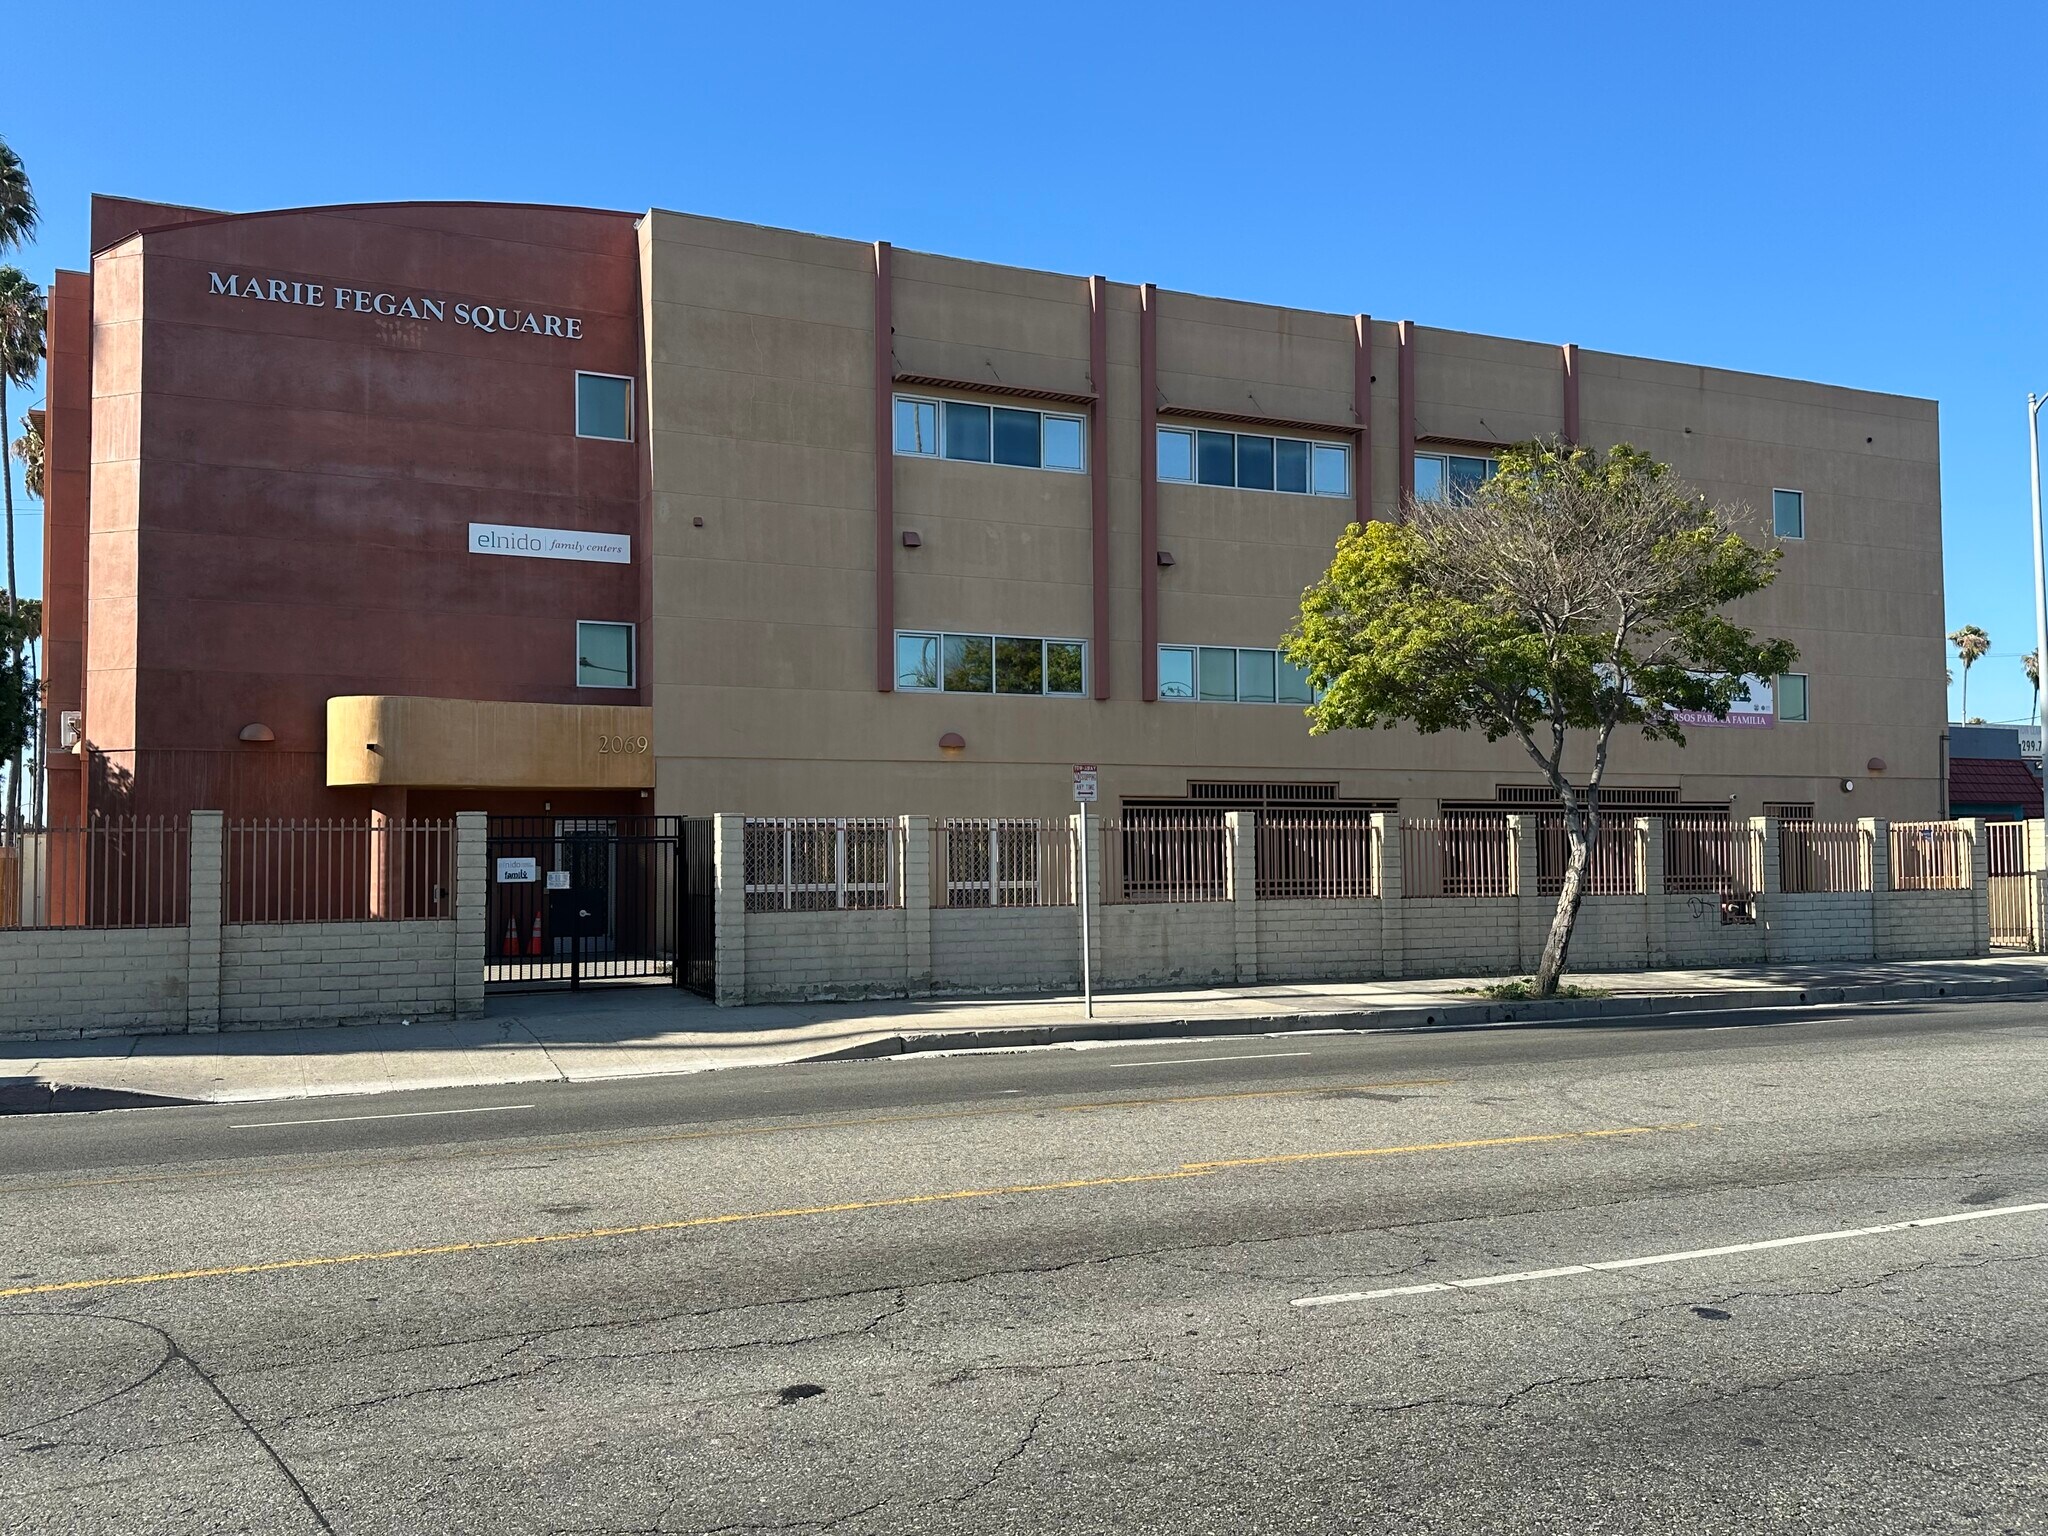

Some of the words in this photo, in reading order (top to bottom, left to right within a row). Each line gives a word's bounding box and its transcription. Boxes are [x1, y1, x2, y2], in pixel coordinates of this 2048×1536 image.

[208, 271, 325, 308] MARIE
[333, 287, 445, 322] FEGAN
[454, 303, 583, 340] SQUARE
[477, 531, 542, 551] elnido
[549, 539, 585, 553] family
[587, 545, 623, 554] centers
[1732, 715, 1766, 725] FAMILIA
[598, 735, 648, 754] 2069
